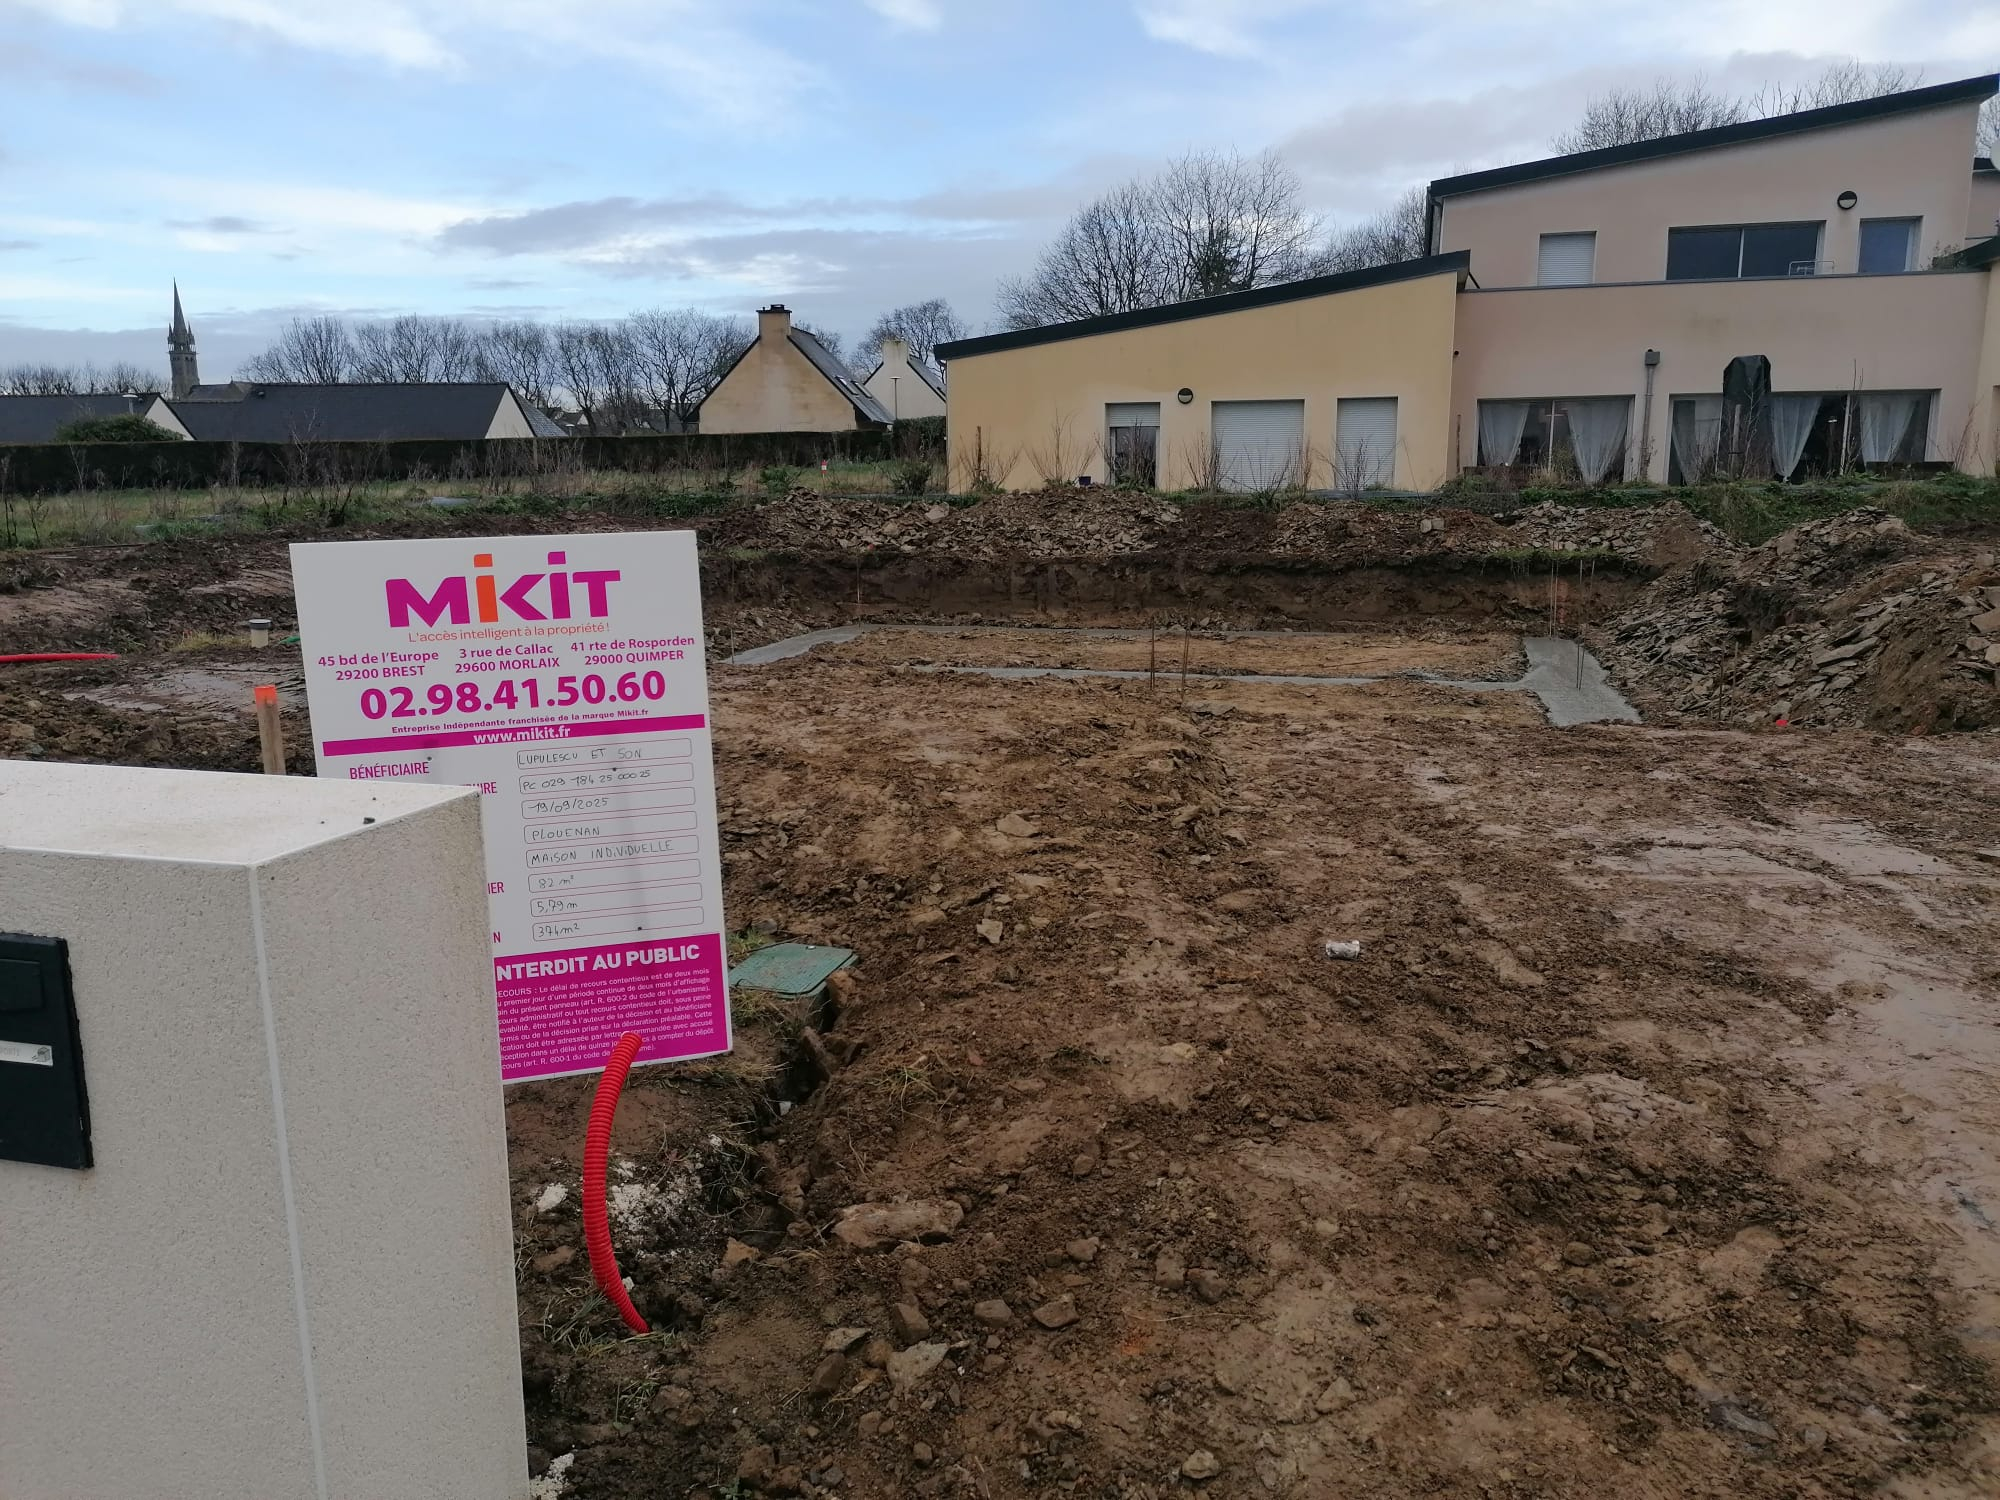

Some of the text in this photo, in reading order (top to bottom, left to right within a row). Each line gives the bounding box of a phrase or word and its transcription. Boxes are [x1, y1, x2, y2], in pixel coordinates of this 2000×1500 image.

[408, 627, 457, 642] L'accès
[460, 626, 521, 641] intelligent
[525, 626, 532, 635] à
[534, 625, 544, 634] la
[459, 644, 553, 658] 3 rue de Callac
[571, 635, 695, 652] 41 rte de Rosporden
[318, 652, 439, 666] 45 bd de l'Europe
[455, 657, 560, 673] 29600 MORLAIX
[584, 650, 684, 665] 29000 QUIMPER
[336, 665, 425, 680] 29200 BREST
[361, 670, 666, 720] 02.98.41.50.60
[392, 724, 440, 734] Entreprise
[508, 714, 555, 725] franchisée
[571, 712, 580, 720] la
[583, 711, 614, 719] marque
[617, 709, 649, 717] Mikit.fr
[474, 725, 571, 744] www.mikit.fr
[591, 748, 606, 759] ET
[618, 748, 642, 759] SON
[350, 762, 430, 779] BÉNÉFICIAIRE
[541, 779, 566, 789] 029
[600, 775, 613, 783] 25
[496, 944, 700, 981] NTERDIT AU PUBLIC
[497, 988, 532, 998] ECOURS
[550, 984, 567, 992] délai
[581, 980, 607, 988] recours
[609, 976, 649, 985] contentieux
[504, 999, 531, 1008] premier
[532, 996, 546, 1005] jour
[569, 991, 595, 1000] période
[597, 986, 625, 995] continue
[499, 1017, 517, 1025] cours
[520, 1012, 563, 1022] administratif
[591, 1005, 617, 1013] recours
[618, 1001, 657, 1010] contentieux
[693, 994, 711, 1003] peine
[510, 1006, 519, 1014] du
[521, 1004, 547, 1015] présent
[549, 1002, 579, 1011] panneau
[532, 1021, 547, 1030] être
[625, 1009, 653, 1018] décision
[500, 1035, 519, 1043] ermis
[551, 1028, 580, 1036] décision
[581, 1025, 599, 1034] prise
[622, 1018, 658, 1028] déclaration
[526, 1040, 539, 1048] doit
[541, 1038, 556, 1046] être
[557, 1036, 589, 1045] adressée
[591, 1034, 602, 1042] par
[690, 1020, 713, 1028] accusé
[560, 1045, 577, 1054] délai
[589, 1042, 610, 1051] quinze
[658, 1032, 685, 1041] compter
[686, 1029, 694, 1037] du
[583, 1051, 600, 1059] code
[601, 1049, 610, 1057] de
